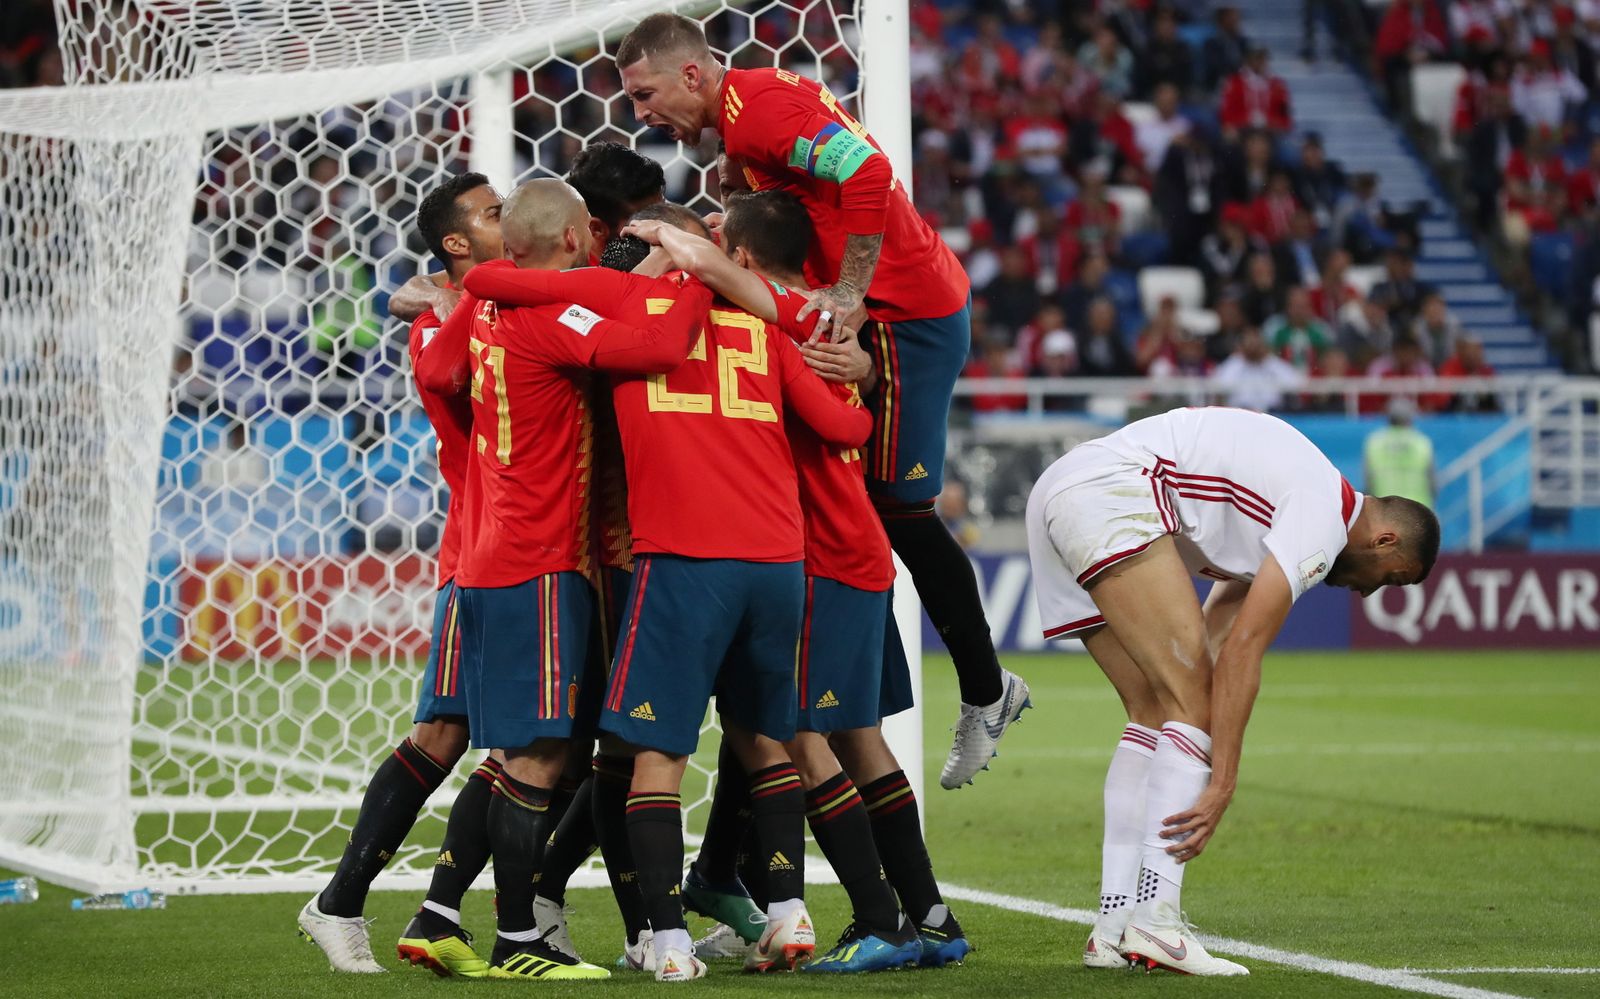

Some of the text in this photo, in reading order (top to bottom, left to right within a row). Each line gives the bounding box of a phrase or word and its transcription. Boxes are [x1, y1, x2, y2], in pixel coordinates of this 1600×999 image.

[645, 297, 779, 424] 22
[904, 471, 929, 481] adidas
[1362, 569, 1600, 644] QATAR
[815, 699, 840, 709] adidas
[629, 711, 657, 722] adidas
[768, 862, 796, 872] adidas
